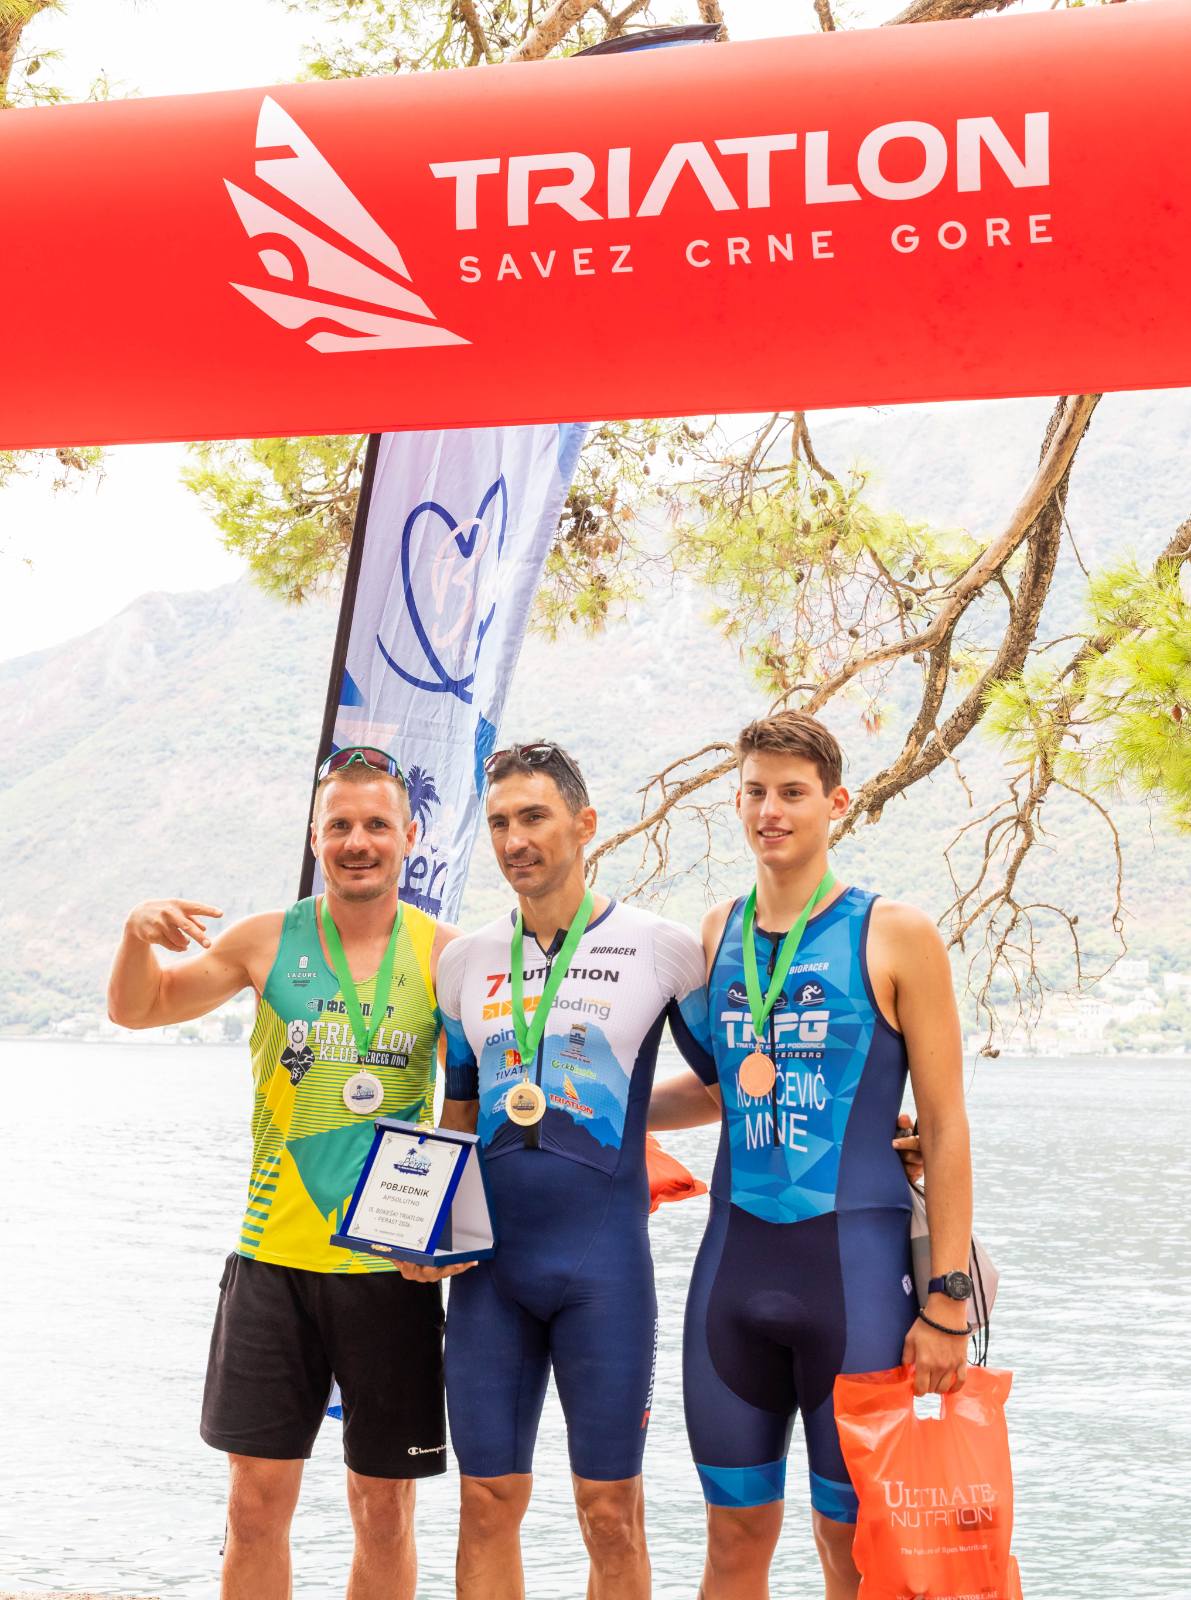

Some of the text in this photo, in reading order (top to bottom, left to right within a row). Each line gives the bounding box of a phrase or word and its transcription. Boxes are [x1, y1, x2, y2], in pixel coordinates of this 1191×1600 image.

[429, 111, 1051, 231] TRIATLON
[459, 213, 1054, 284] SAVEZ CRNE GORE
[590, 946, 637, 957] BIORACER
[789, 962, 830, 975] BIORACER
[312, 1021, 418, 1055] TRILON
[366, 1052, 391, 1066] ERCEG
[745, 1111, 808, 1153] MNE
[380, 1181, 430, 1198] POBJEDNIK
[882, 1480, 996, 1509] ULTIMATE
